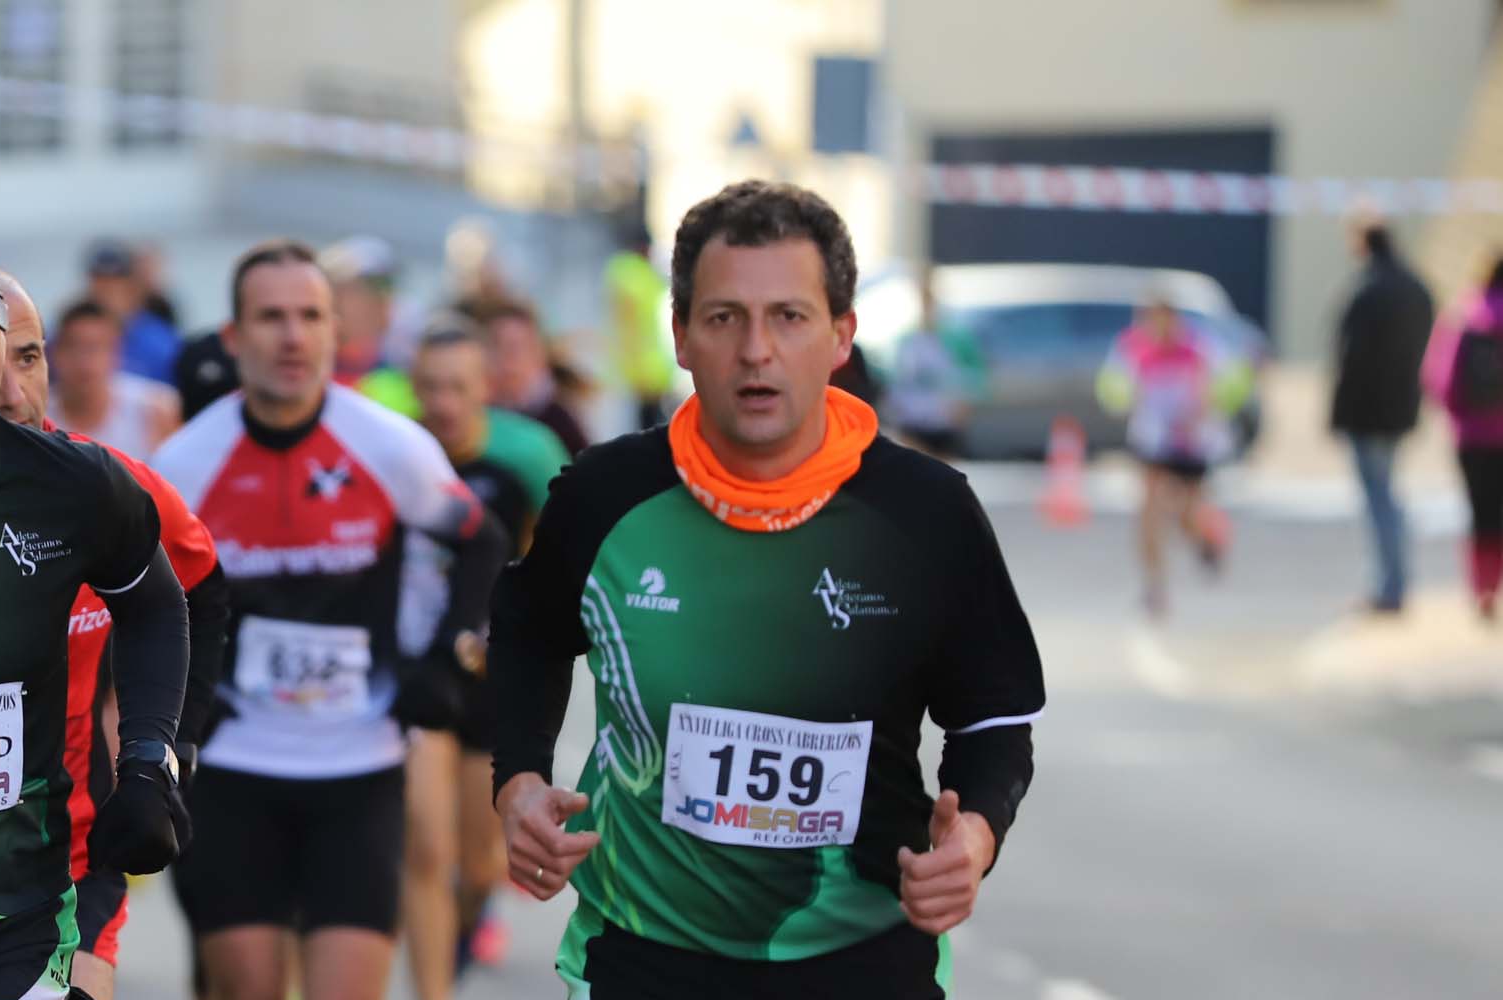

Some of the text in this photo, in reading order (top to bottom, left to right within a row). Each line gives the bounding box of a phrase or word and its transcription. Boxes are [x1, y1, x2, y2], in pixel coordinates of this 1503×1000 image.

[626, 593, 680, 612] VIATOR
[714, 720, 742, 740] LIGA
[745, 724, 786, 744] CROSS
[788, 729, 864, 751] CABRERIZOS
[709, 744, 825, 807] 159
[676, 795, 844, 833] JOMISAGA
[754, 832, 838, 845] REFORMAS
